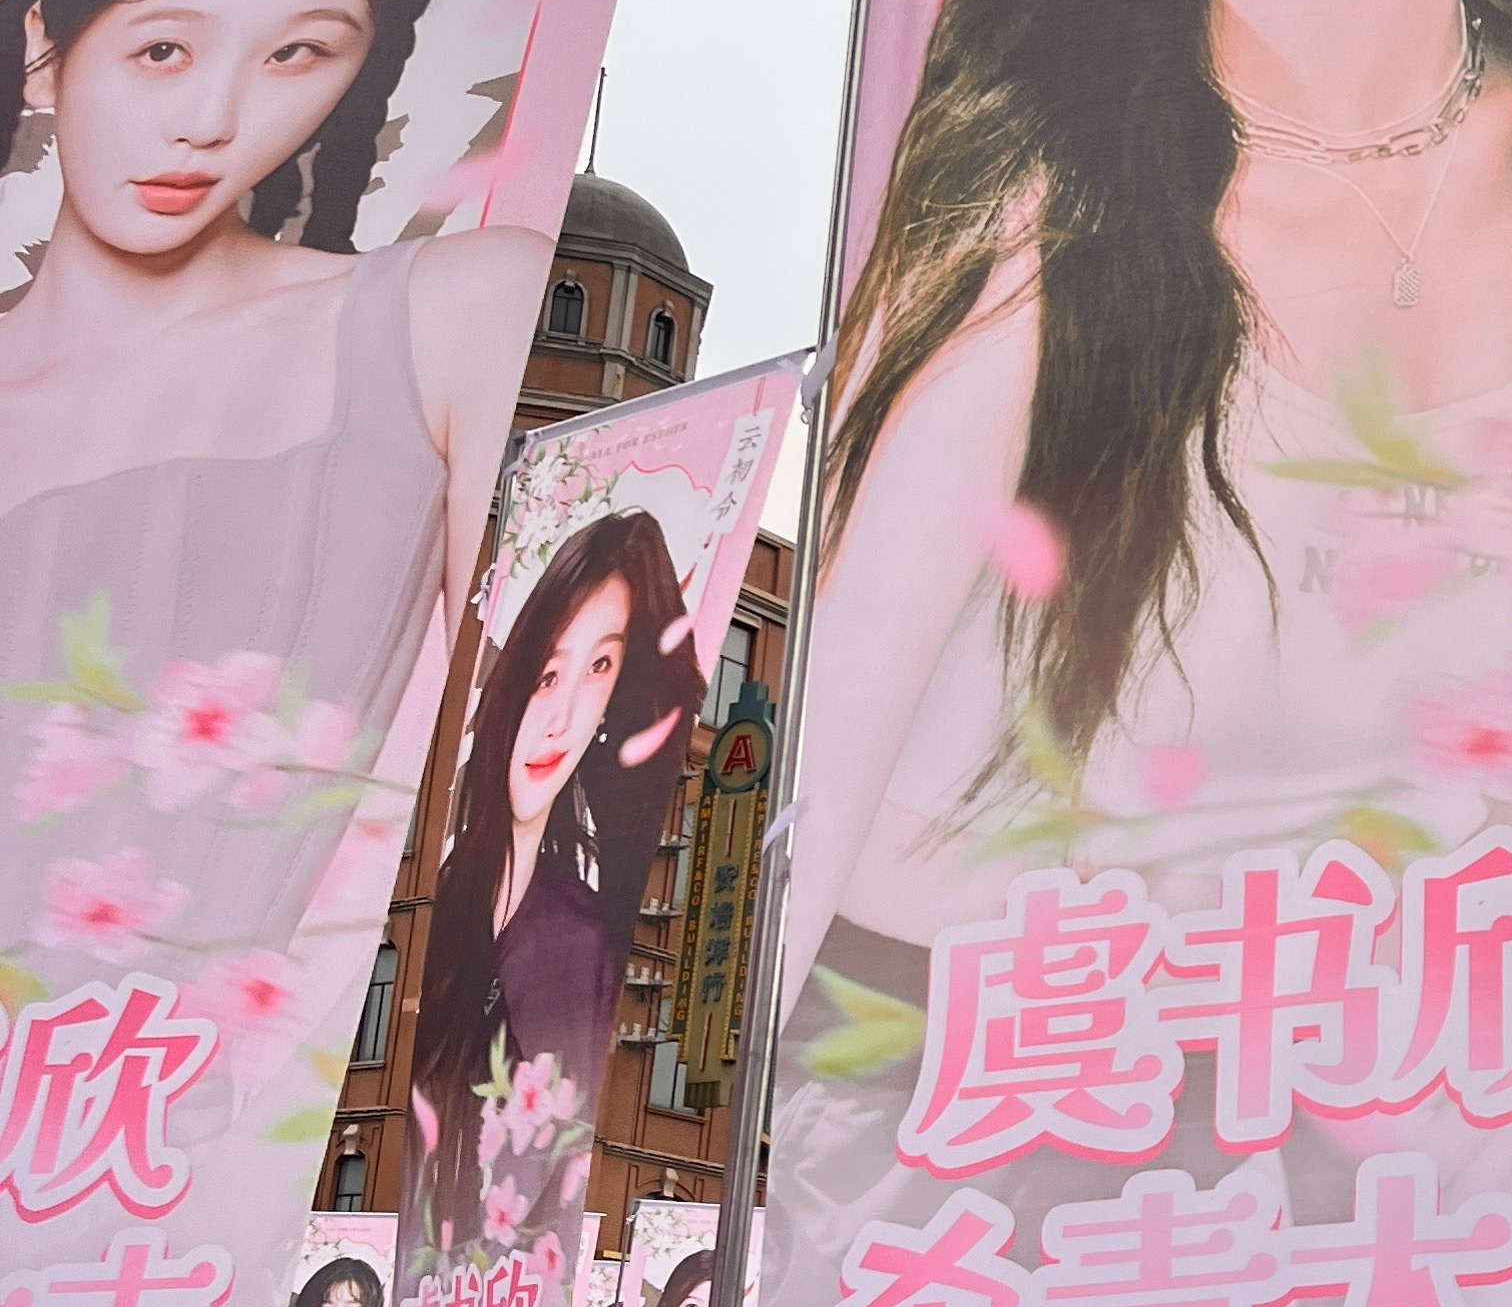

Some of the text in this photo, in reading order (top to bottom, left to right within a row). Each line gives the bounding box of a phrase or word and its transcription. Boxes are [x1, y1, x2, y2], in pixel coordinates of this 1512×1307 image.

[707, 424, 763, 522] 云初令
[719, 733, 758, 776] A
